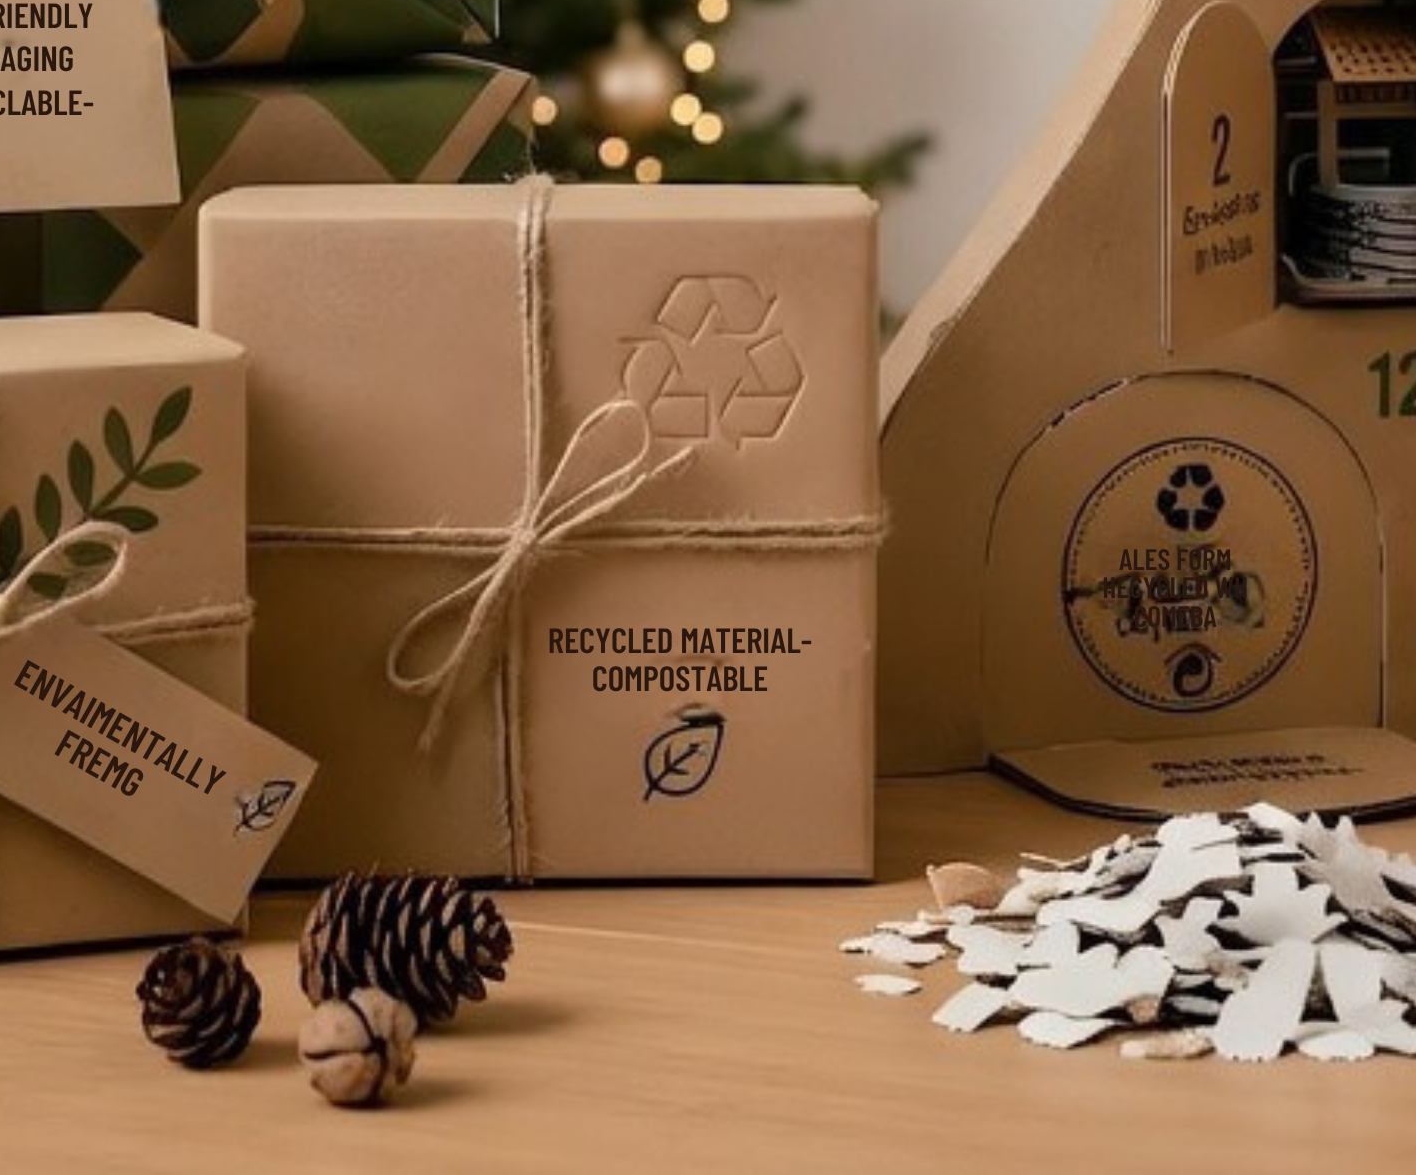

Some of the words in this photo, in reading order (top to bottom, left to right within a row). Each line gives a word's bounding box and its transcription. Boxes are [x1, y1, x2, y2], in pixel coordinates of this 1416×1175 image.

[1212, 114, 1231, 186] 2
[1119, 549, 1170, 571] ALES
[1177, 549, 1231, 571] FORM
[548, 628, 672, 654] RECYCLED
[681, 628, 812, 654] MATERIAL-
[592, 665, 768, 692] COMPOSTABLE
[14, 660, 226, 795] ENVAIMENTALLY
[54, 730, 144, 797] FREMG
